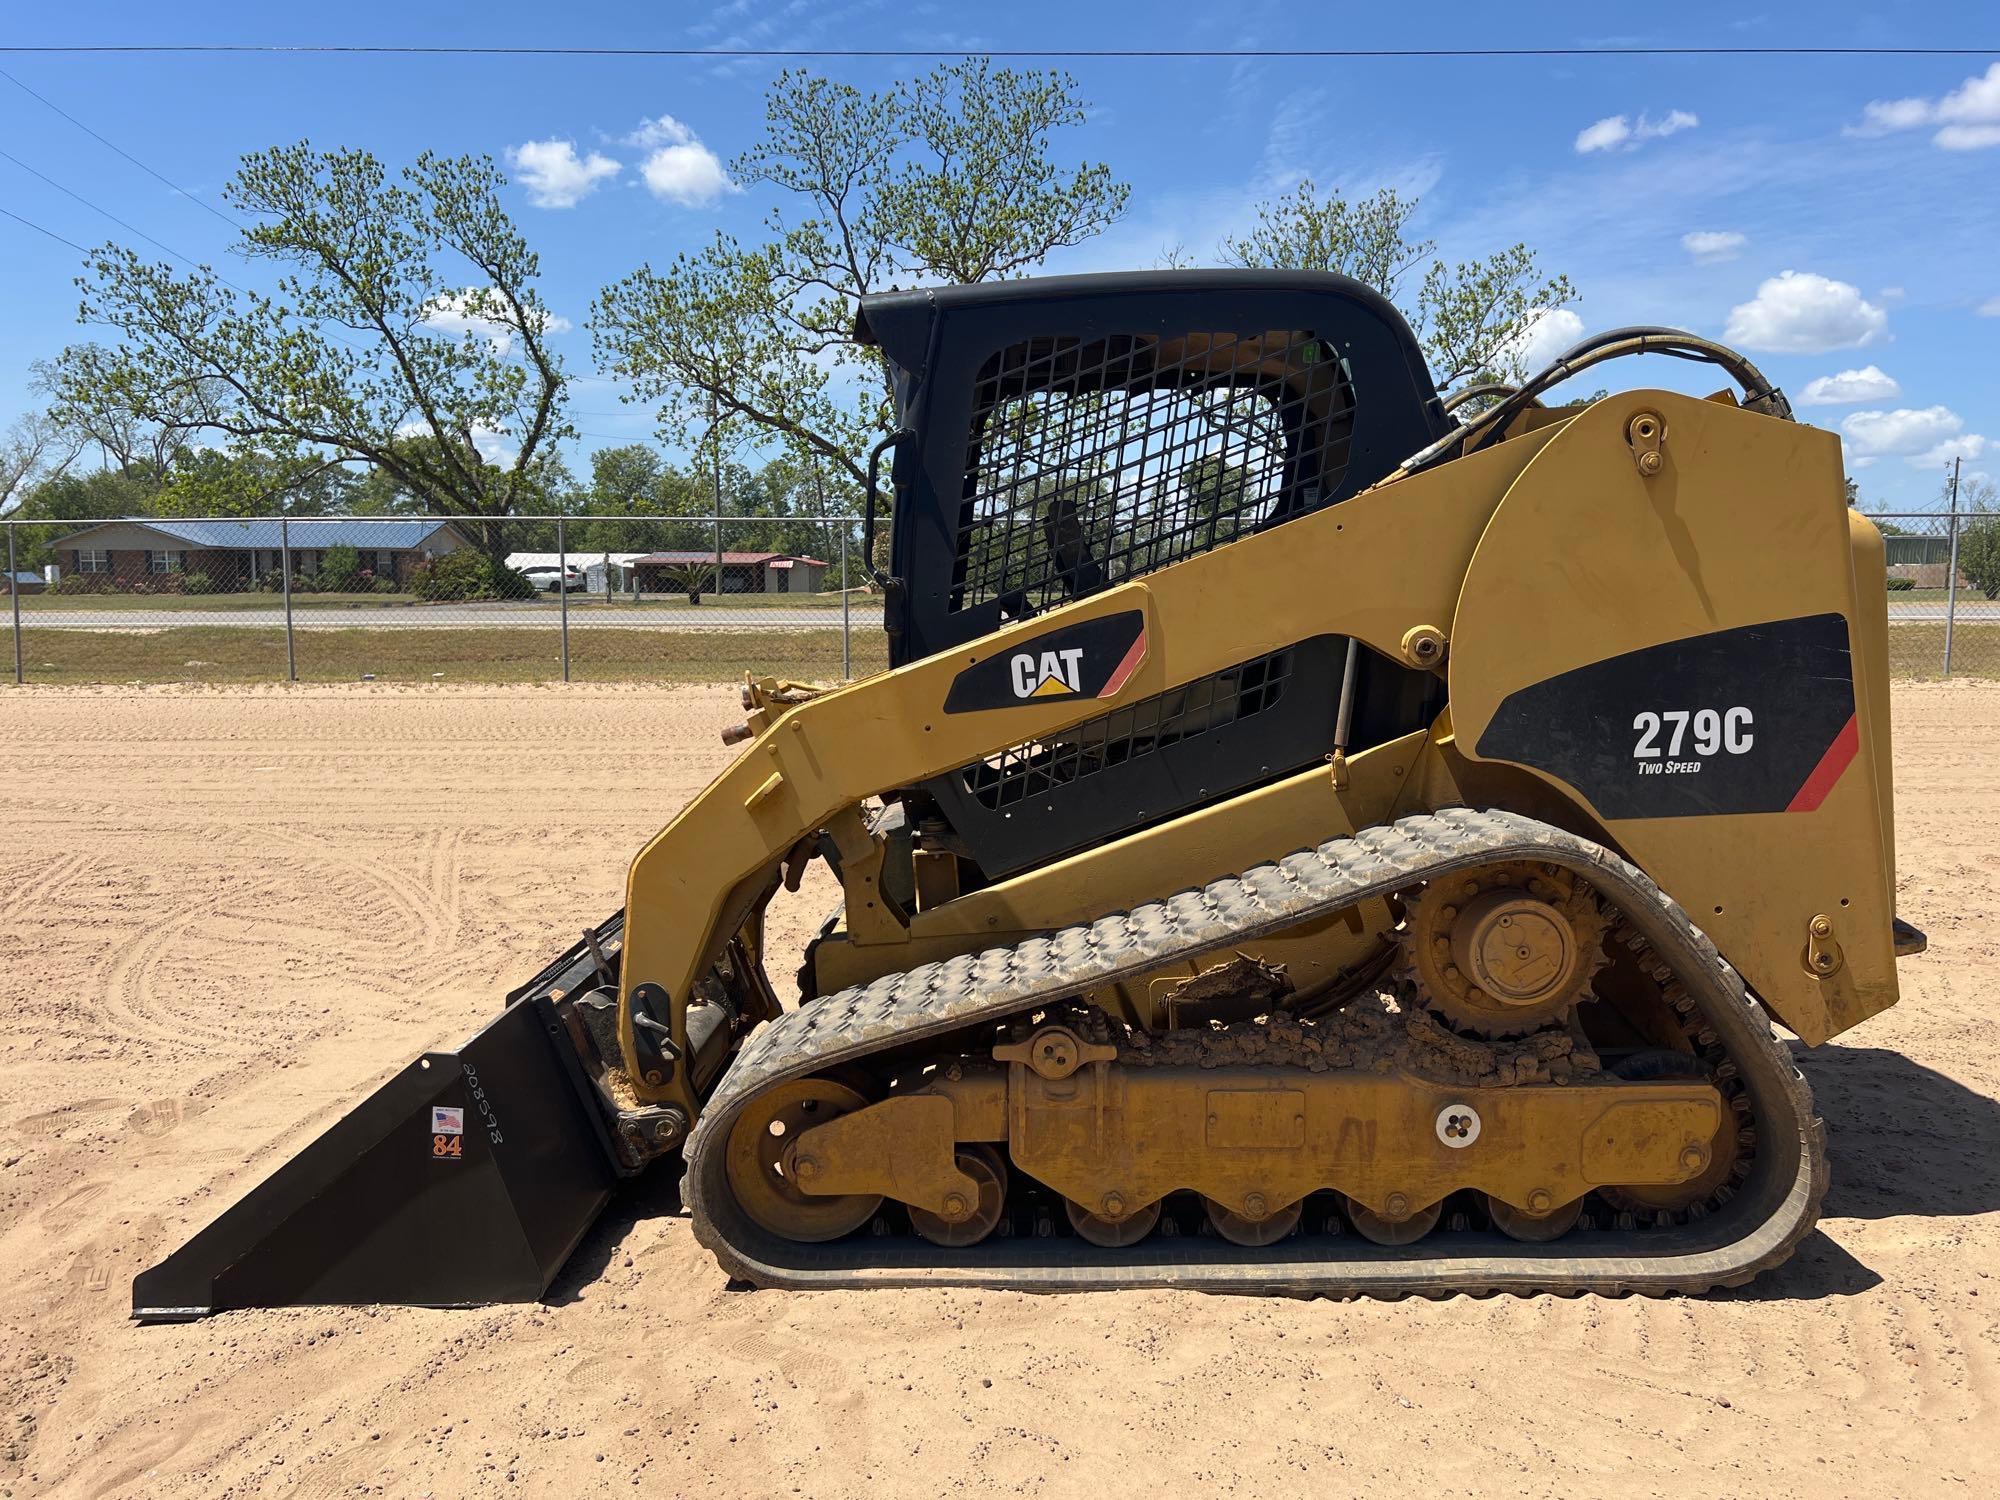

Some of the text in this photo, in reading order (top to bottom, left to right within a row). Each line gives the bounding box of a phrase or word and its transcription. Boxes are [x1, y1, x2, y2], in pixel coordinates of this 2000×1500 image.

[1010, 648, 1083, 698] CAT
[1633, 706, 1754, 758] 279C
[463, 1063, 503, 1144] 208598
[433, 1135, 462, 1156] 84
